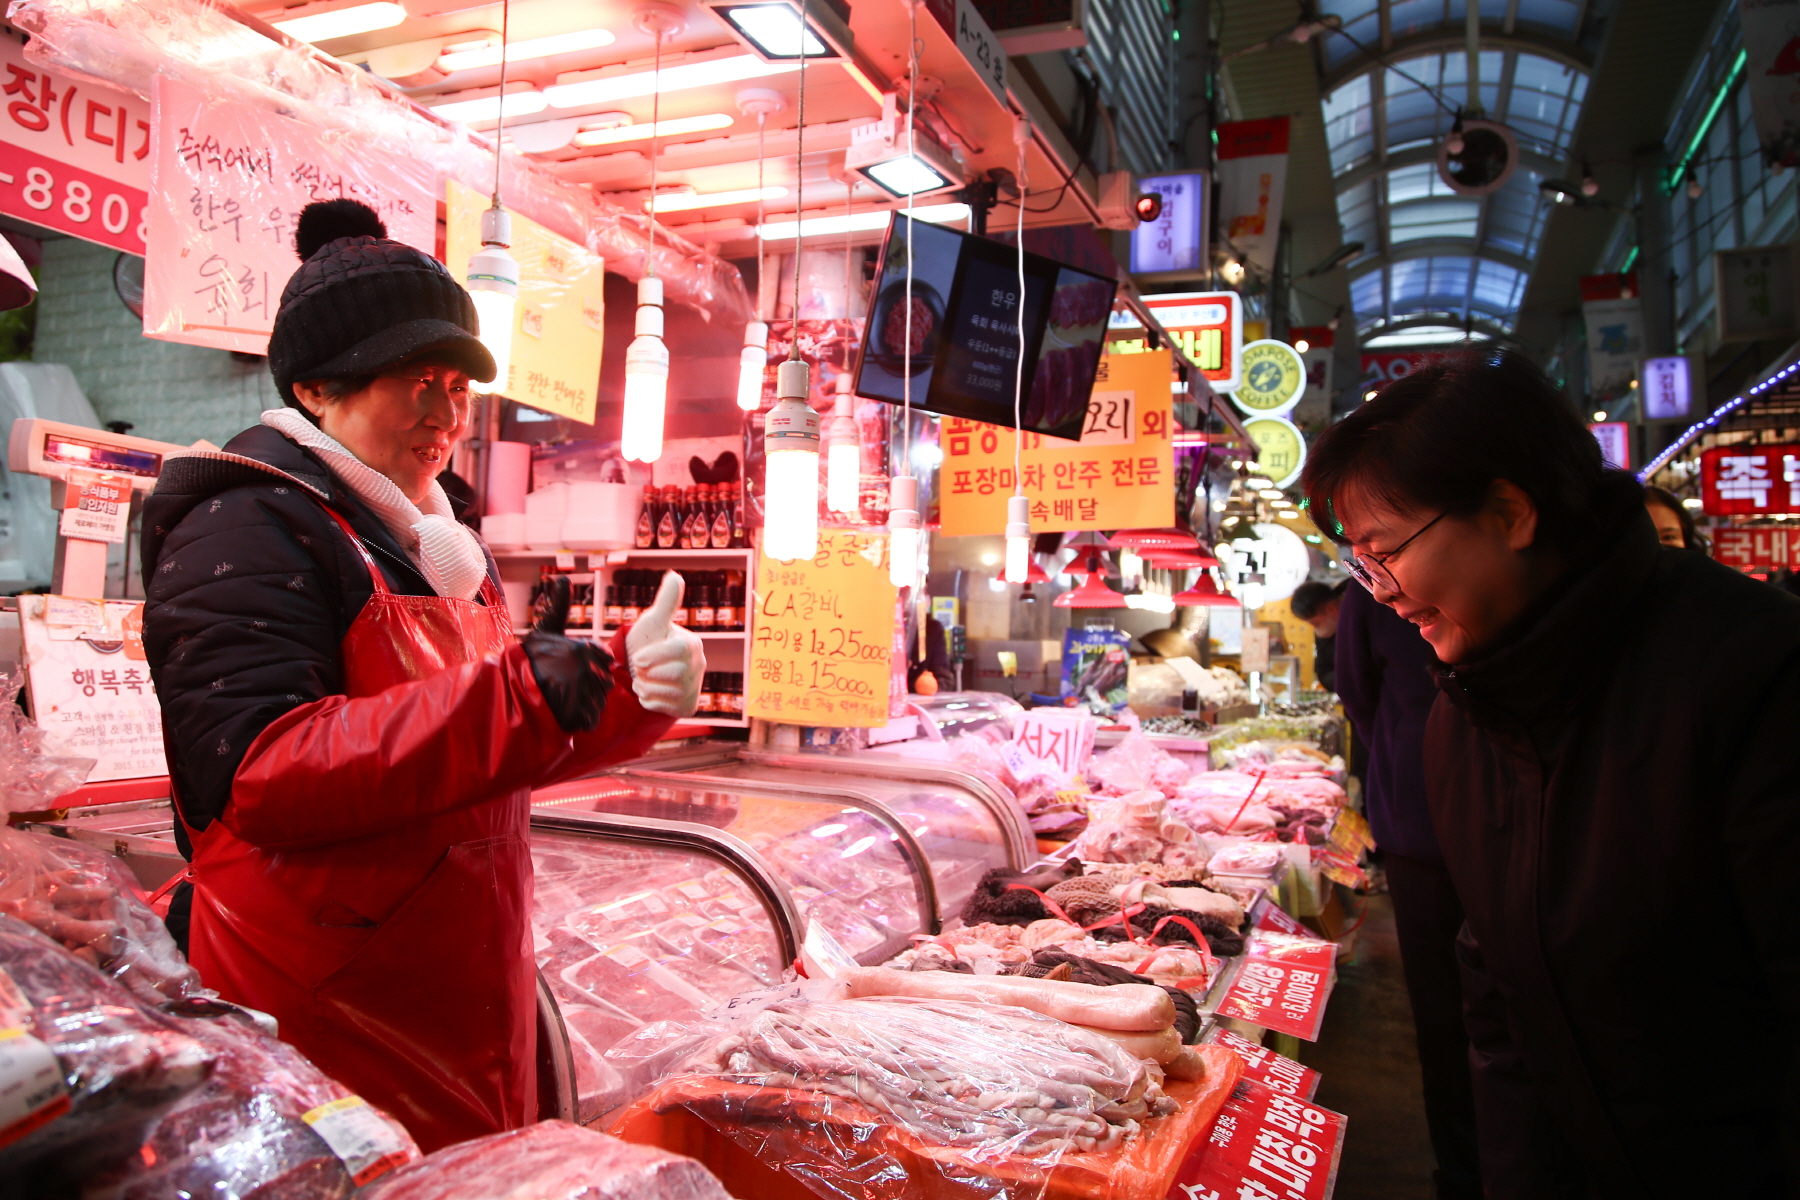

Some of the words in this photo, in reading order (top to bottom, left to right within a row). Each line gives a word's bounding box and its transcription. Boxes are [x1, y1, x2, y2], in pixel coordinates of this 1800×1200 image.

[991, 289, 1016, 310] 한우
[1142, 409, 1167, 440] 외
[952, 463, 1046, 495] 포장마차
[1053, 460, 1102, 490] 안주
[1111, 457, 1161, 487] 전문
